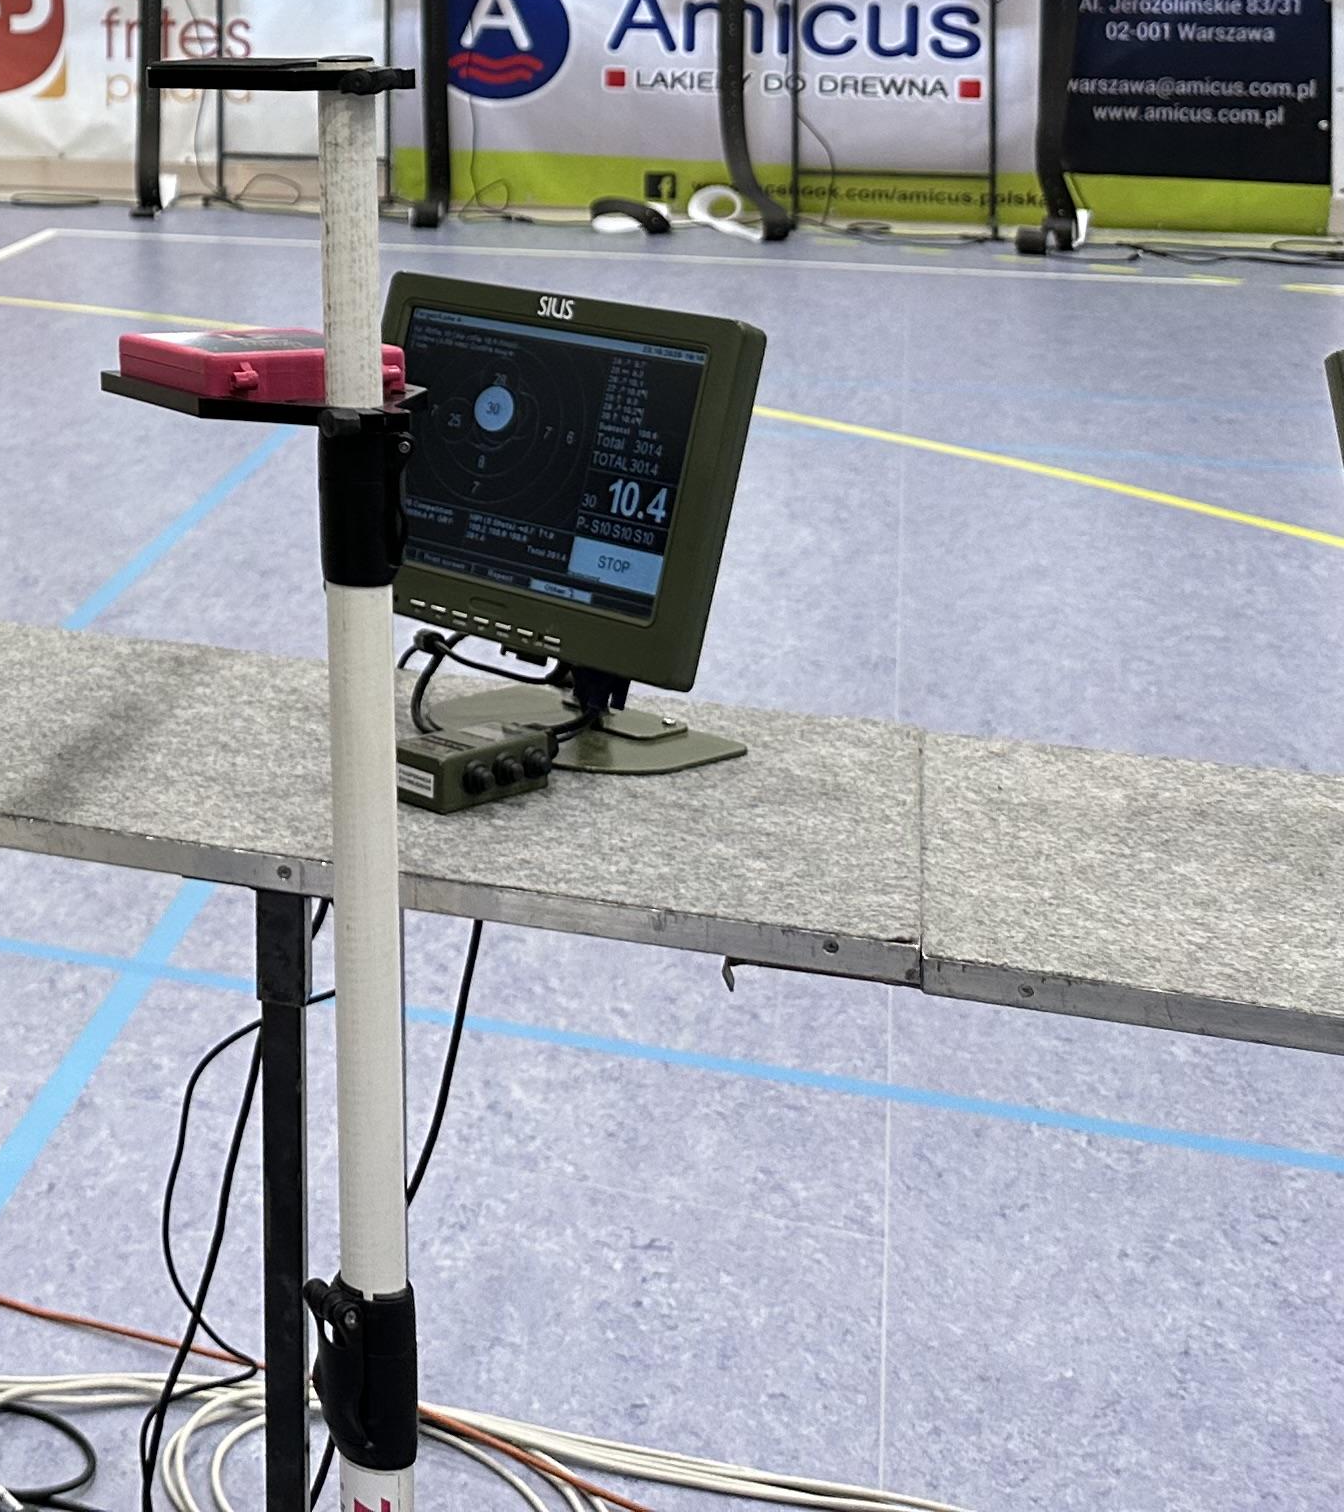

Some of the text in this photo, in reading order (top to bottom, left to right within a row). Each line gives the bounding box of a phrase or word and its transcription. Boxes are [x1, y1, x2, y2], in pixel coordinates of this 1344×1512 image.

[102, 7, 251, 60] frtes
[1105, 22, 1275, 42] 02-001 Warszawa
[636, 70, 753, 94] LAKIEY
[819, 76, 948, 99] DREWNA
[1093, 104, 1285, 128] www.amicus.com.pl
[537, 295, 576, 321] SIUS
[486, 401, 500, 415] 30
[596, 432, 625, 451] Total
[592, 450, 628, 471] TOTAL
[582, 478, 669, 524] 30 10.4
[597, 555, 631, 574] STOP
